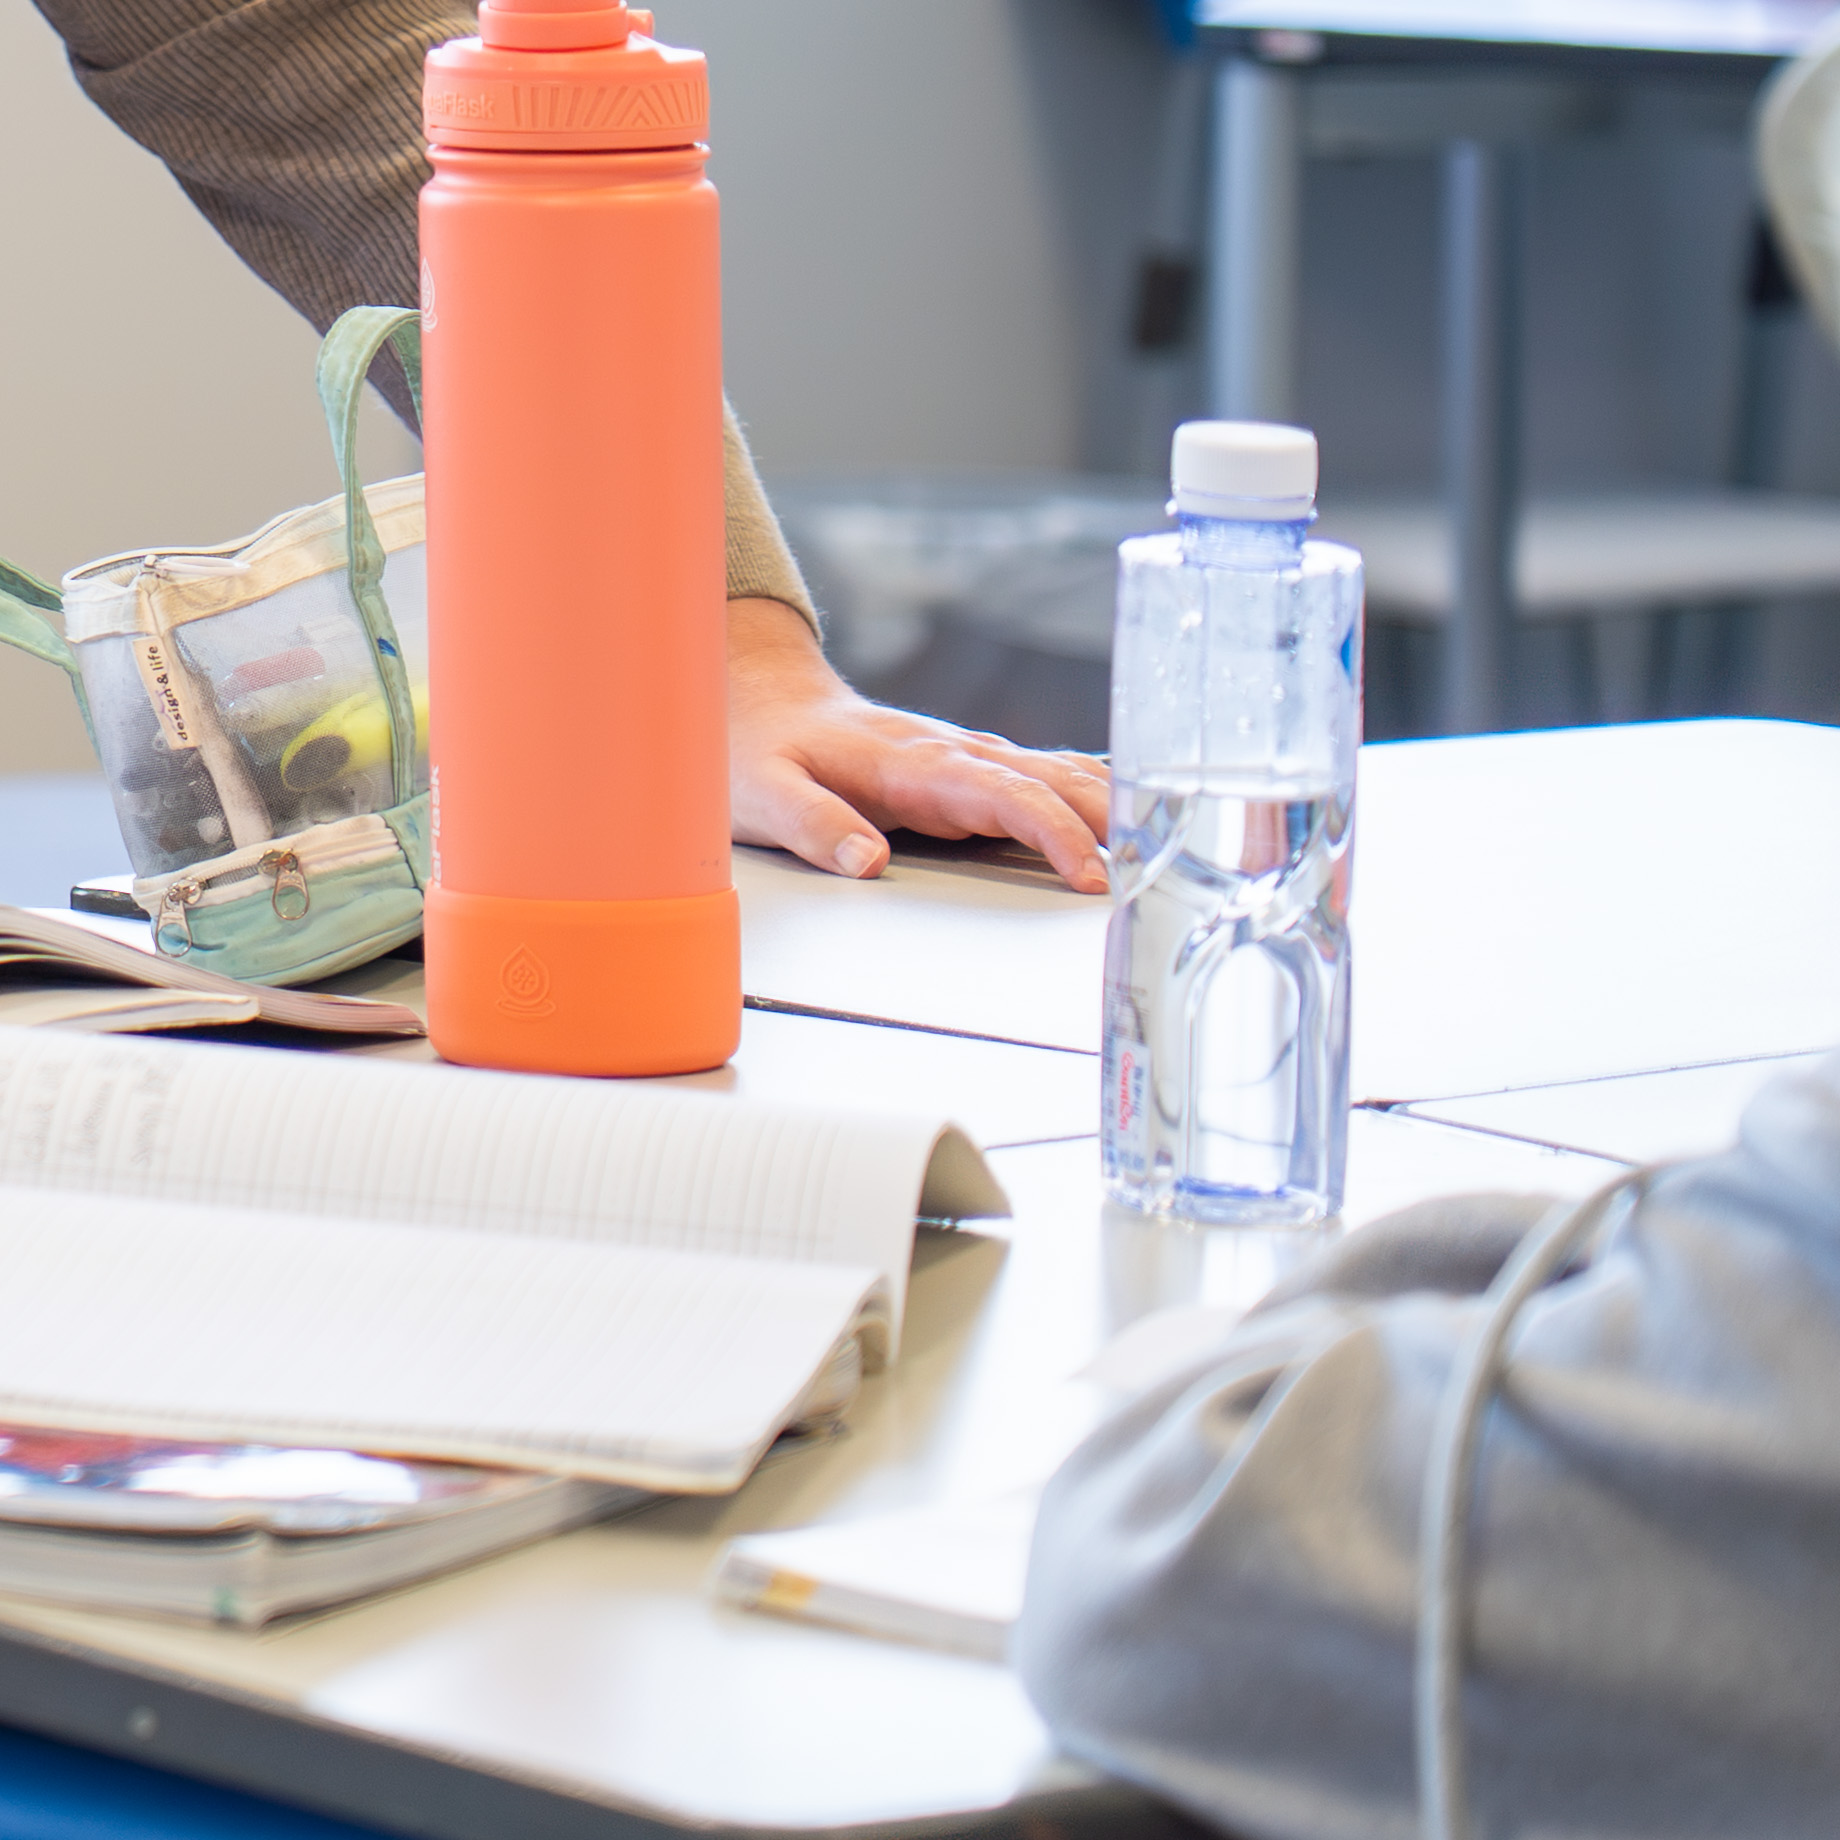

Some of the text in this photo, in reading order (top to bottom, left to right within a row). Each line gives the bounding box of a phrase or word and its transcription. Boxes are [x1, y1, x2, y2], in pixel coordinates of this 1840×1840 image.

[148, 646, 188, 741] design & life
